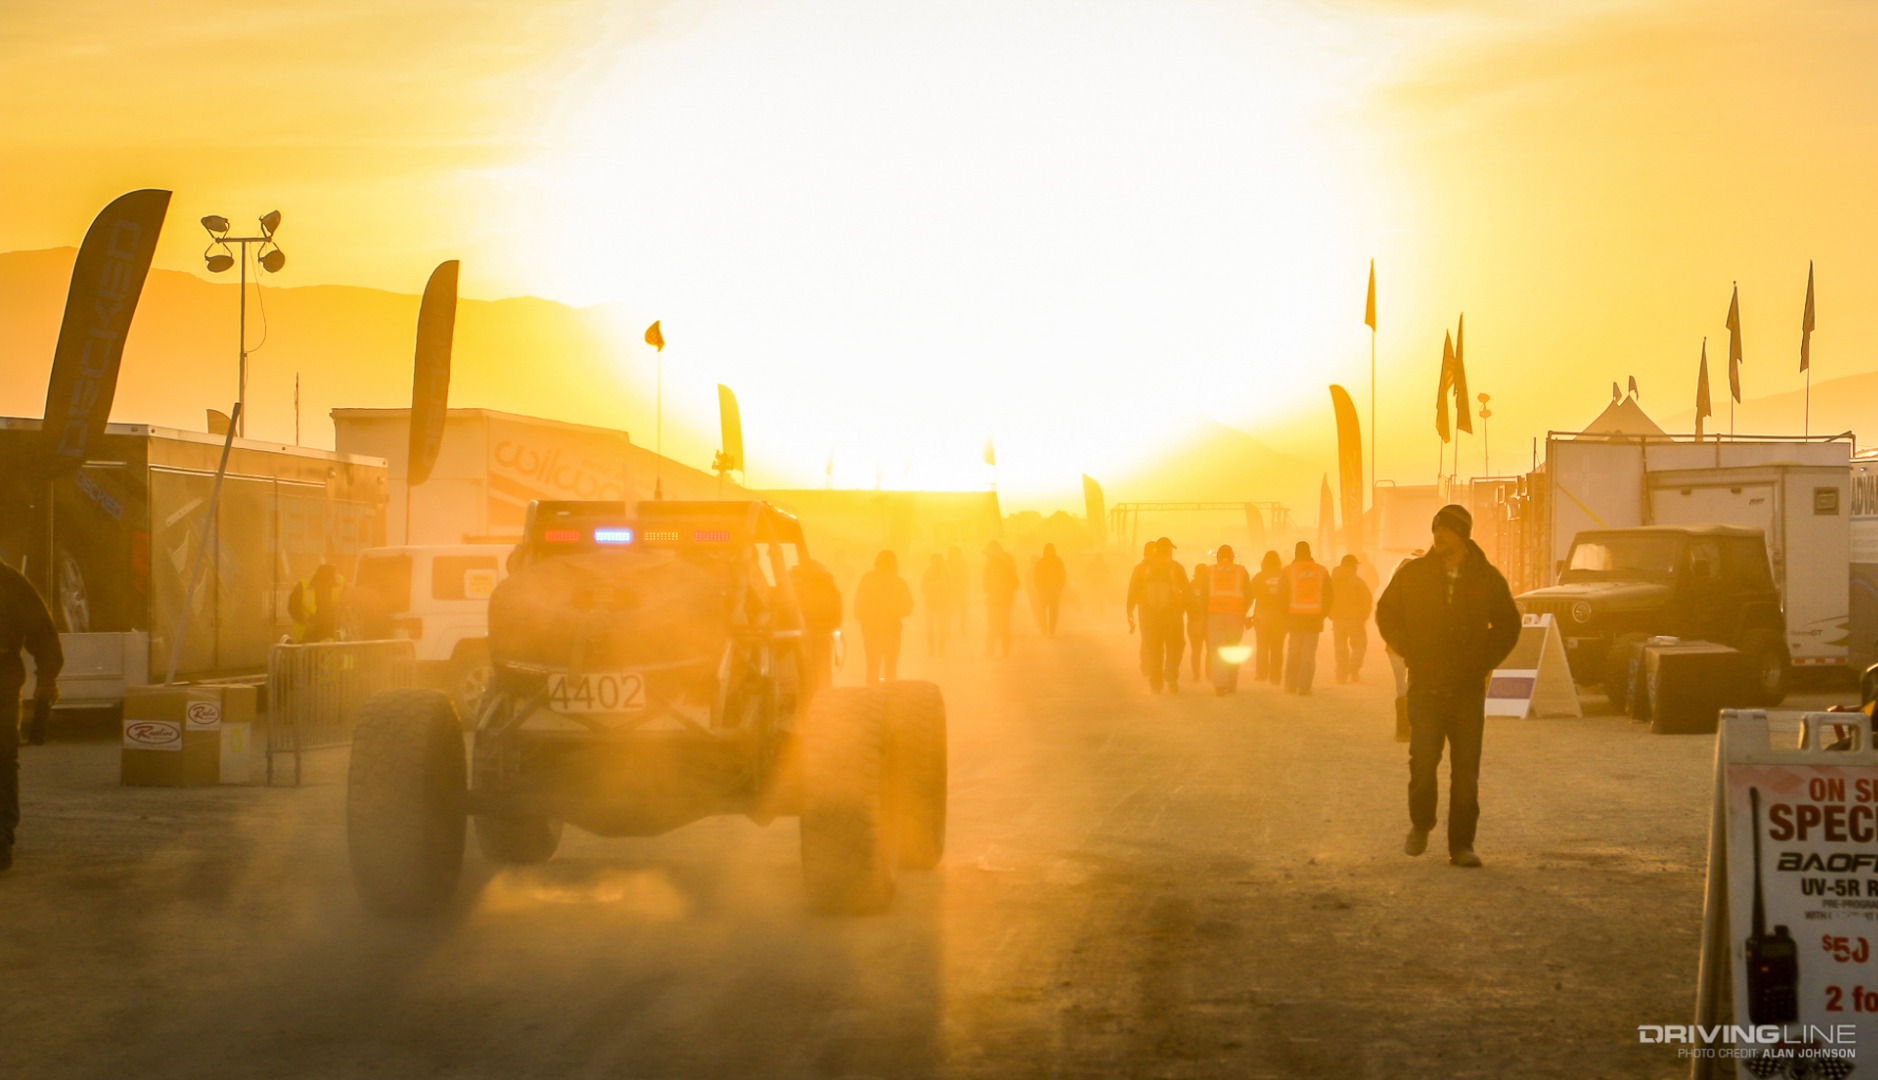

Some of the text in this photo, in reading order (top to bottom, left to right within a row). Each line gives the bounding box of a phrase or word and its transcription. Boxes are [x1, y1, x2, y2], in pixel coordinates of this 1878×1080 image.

[57, 218, 142, 458] DECKED
[1851, 476, 1878, 515] ADVA
[550, 674, 644, 710] 4402
[1810, 778, 1846, 803] ON
[1769, 804, 1878, 842] SPEC
[1777, 852, 1878, 872] BAOF
[1801, 878, 1860, 897] UV-5R
[1821, 933, 1870, 964] $50
[1825, 985, 1844, 1012] 2
